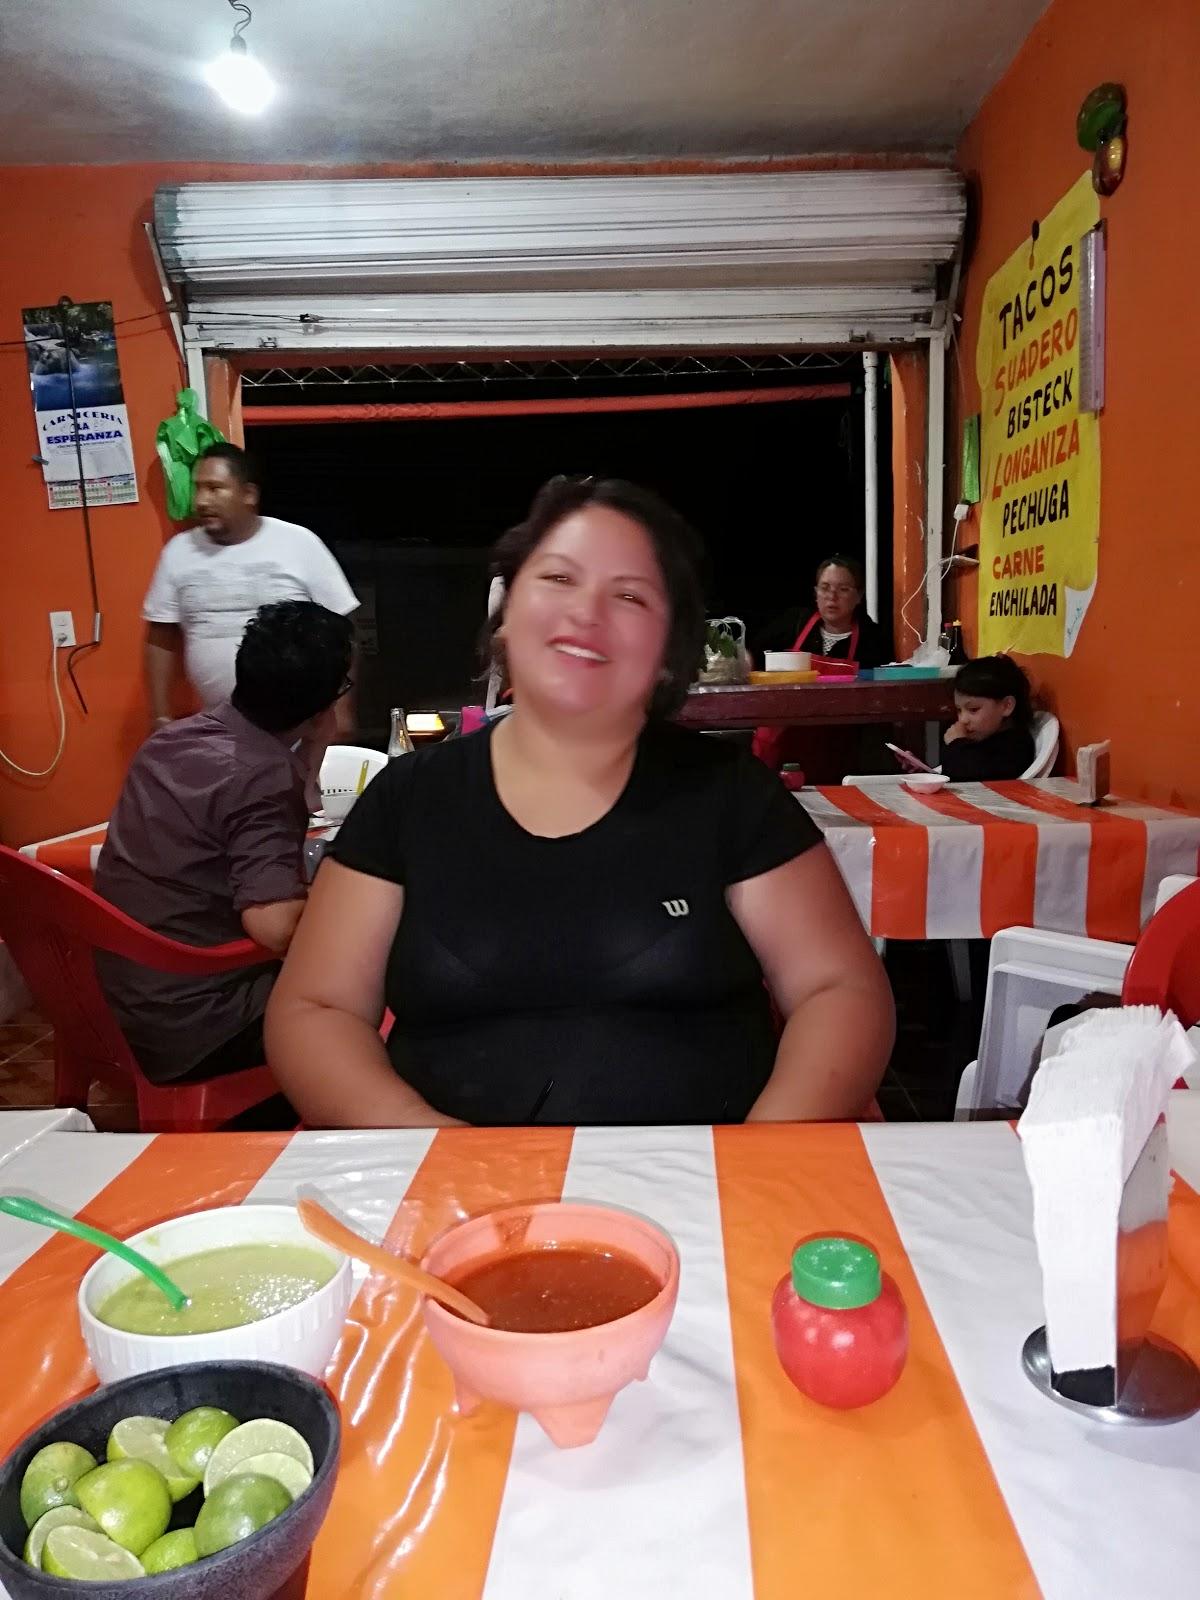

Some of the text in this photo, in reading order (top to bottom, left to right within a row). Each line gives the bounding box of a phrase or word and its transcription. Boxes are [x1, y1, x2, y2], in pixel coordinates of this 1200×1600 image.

[999, 245, 1073, 350] TACOS
[994, 307, 1078, 416] SUADERO
[1007, 368, 1073, 439] BISTECK
[46, 430, 123, 444] ESPERANZA
[992, 420, 1080, 500] LONGANIZA
[1003, 480, 1070, 538] PECHUGA
[993, 545, 1045, 580] CARNE
[989, 583, 1058, 617] ENCHILADA
